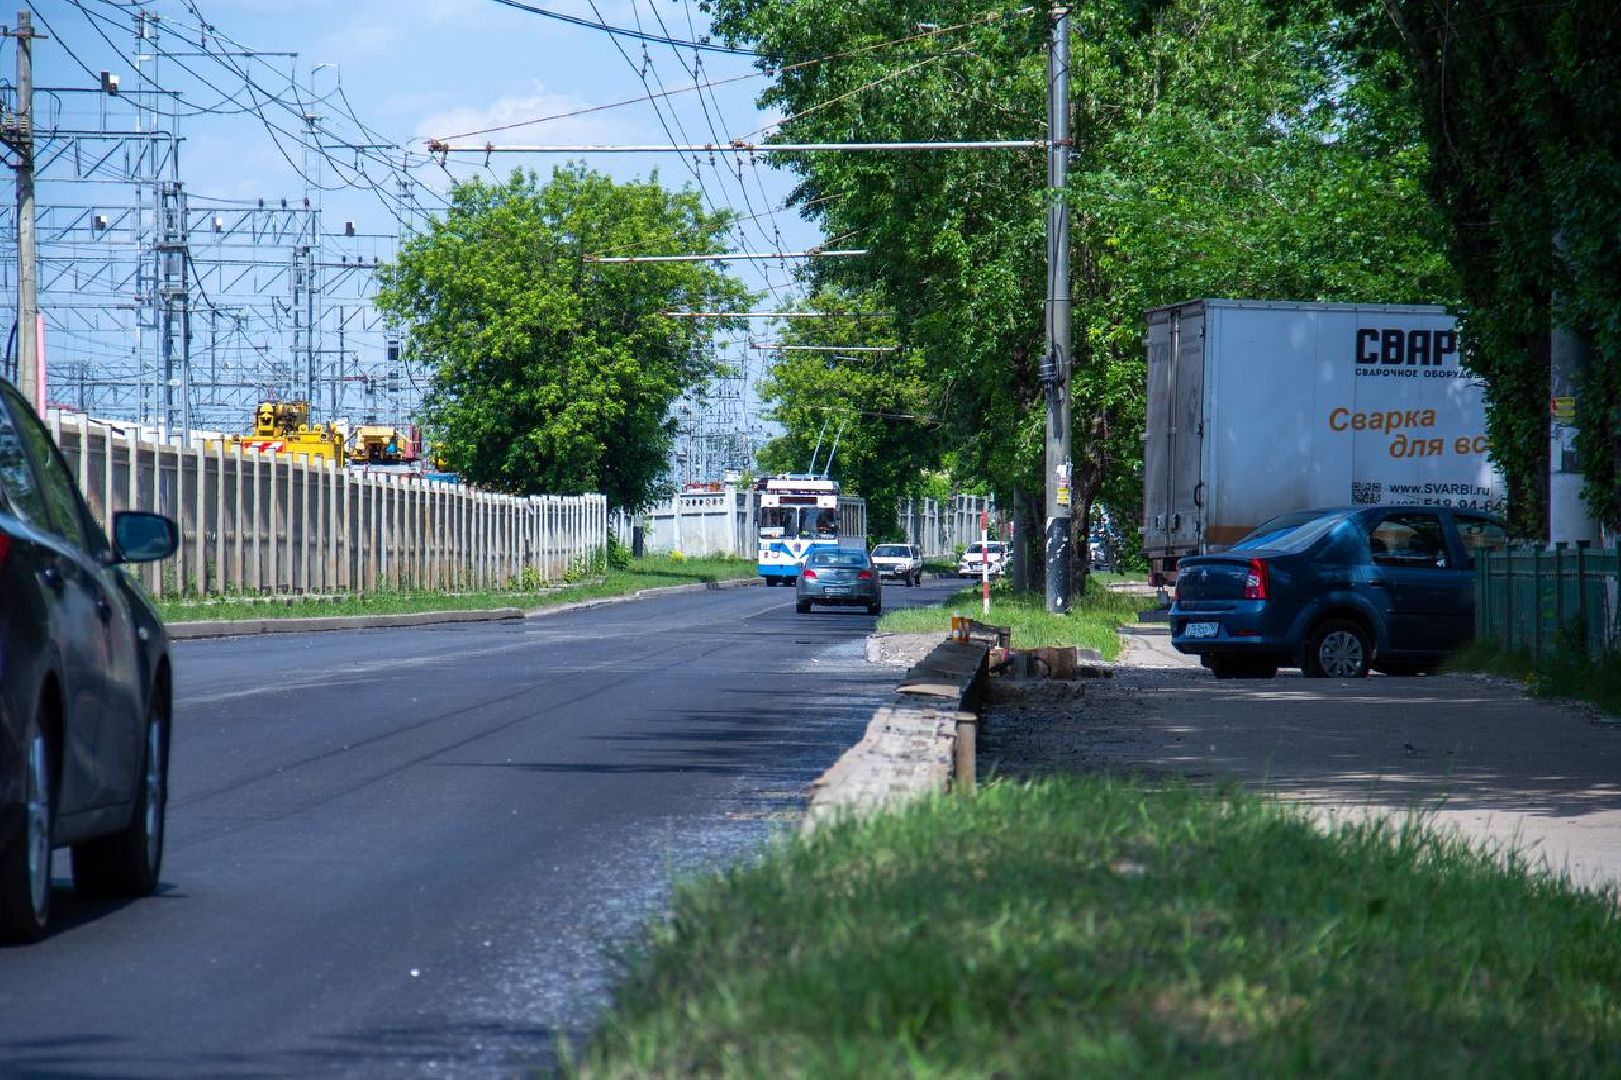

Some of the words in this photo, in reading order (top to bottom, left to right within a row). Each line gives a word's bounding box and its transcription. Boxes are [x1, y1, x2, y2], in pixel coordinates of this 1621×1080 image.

[1355, 328, 1459, 366] СВАР
[1354, 368, 1419, 378] СВАРОЧНОЕ
[1423, 369, 1481, 379] ОБОРУДО
[1328, 407, 1437, 435] Сварка
[1388, 434, 1445, 459] для
[1453, 434, 1490, 456] вс
